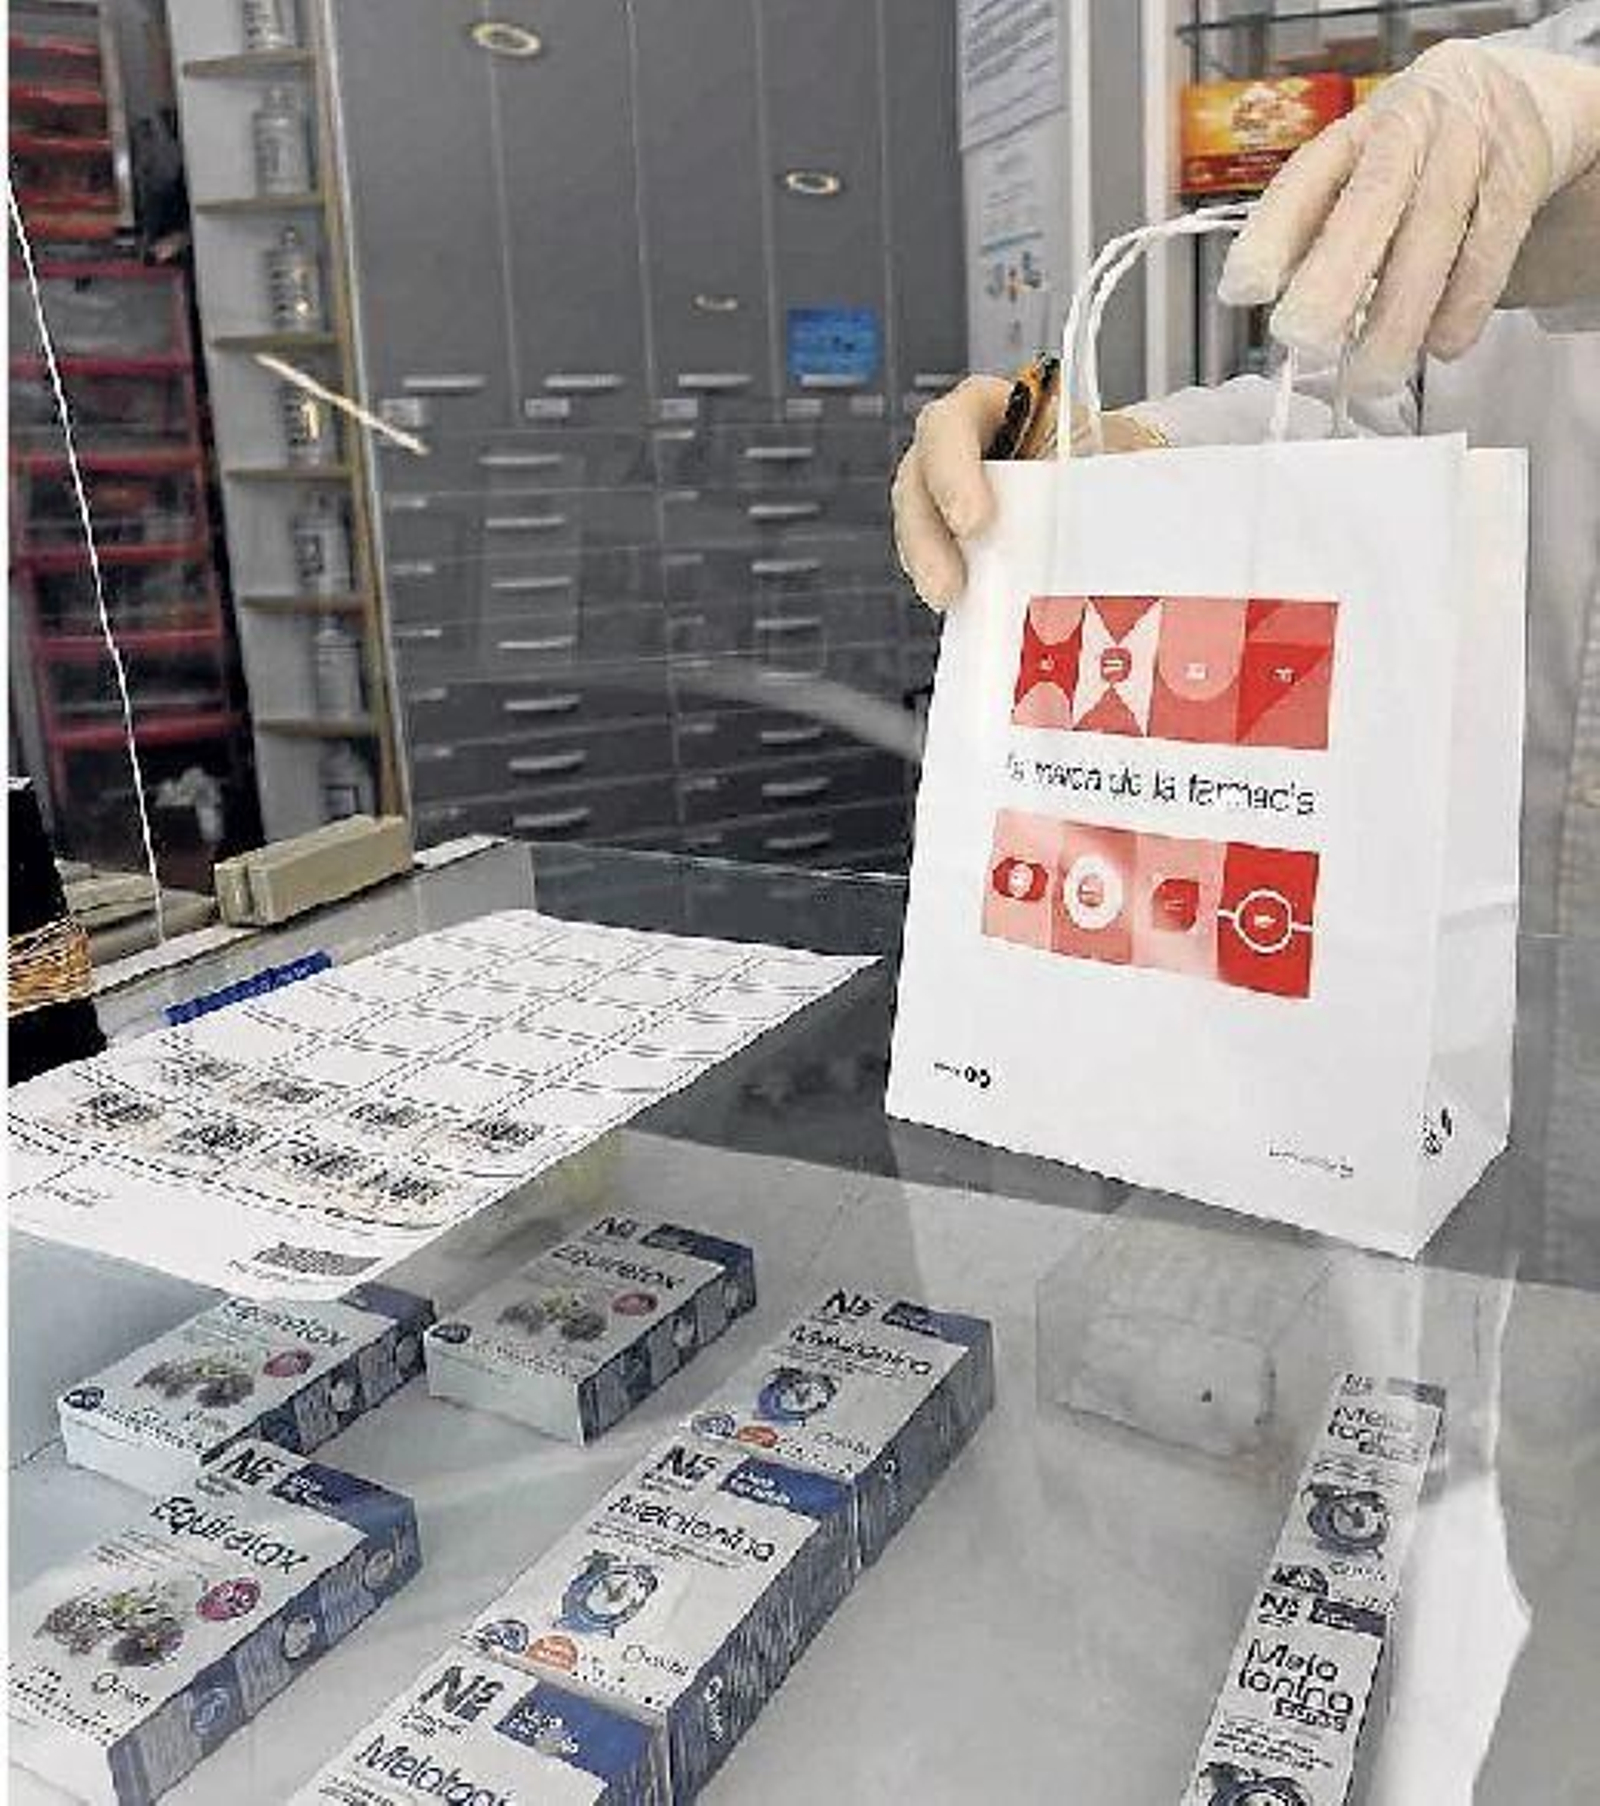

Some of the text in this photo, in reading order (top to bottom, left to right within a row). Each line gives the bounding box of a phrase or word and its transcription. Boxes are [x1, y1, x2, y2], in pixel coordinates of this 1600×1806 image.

[1035, 760, 1102, 791] marca
[1110, 766, 1142, 797] de
[1153, 769, 1176, 801] la
[1188, 772, 1316, 816] farmacia
[607, 1493, 776, 1563] Melatonina
